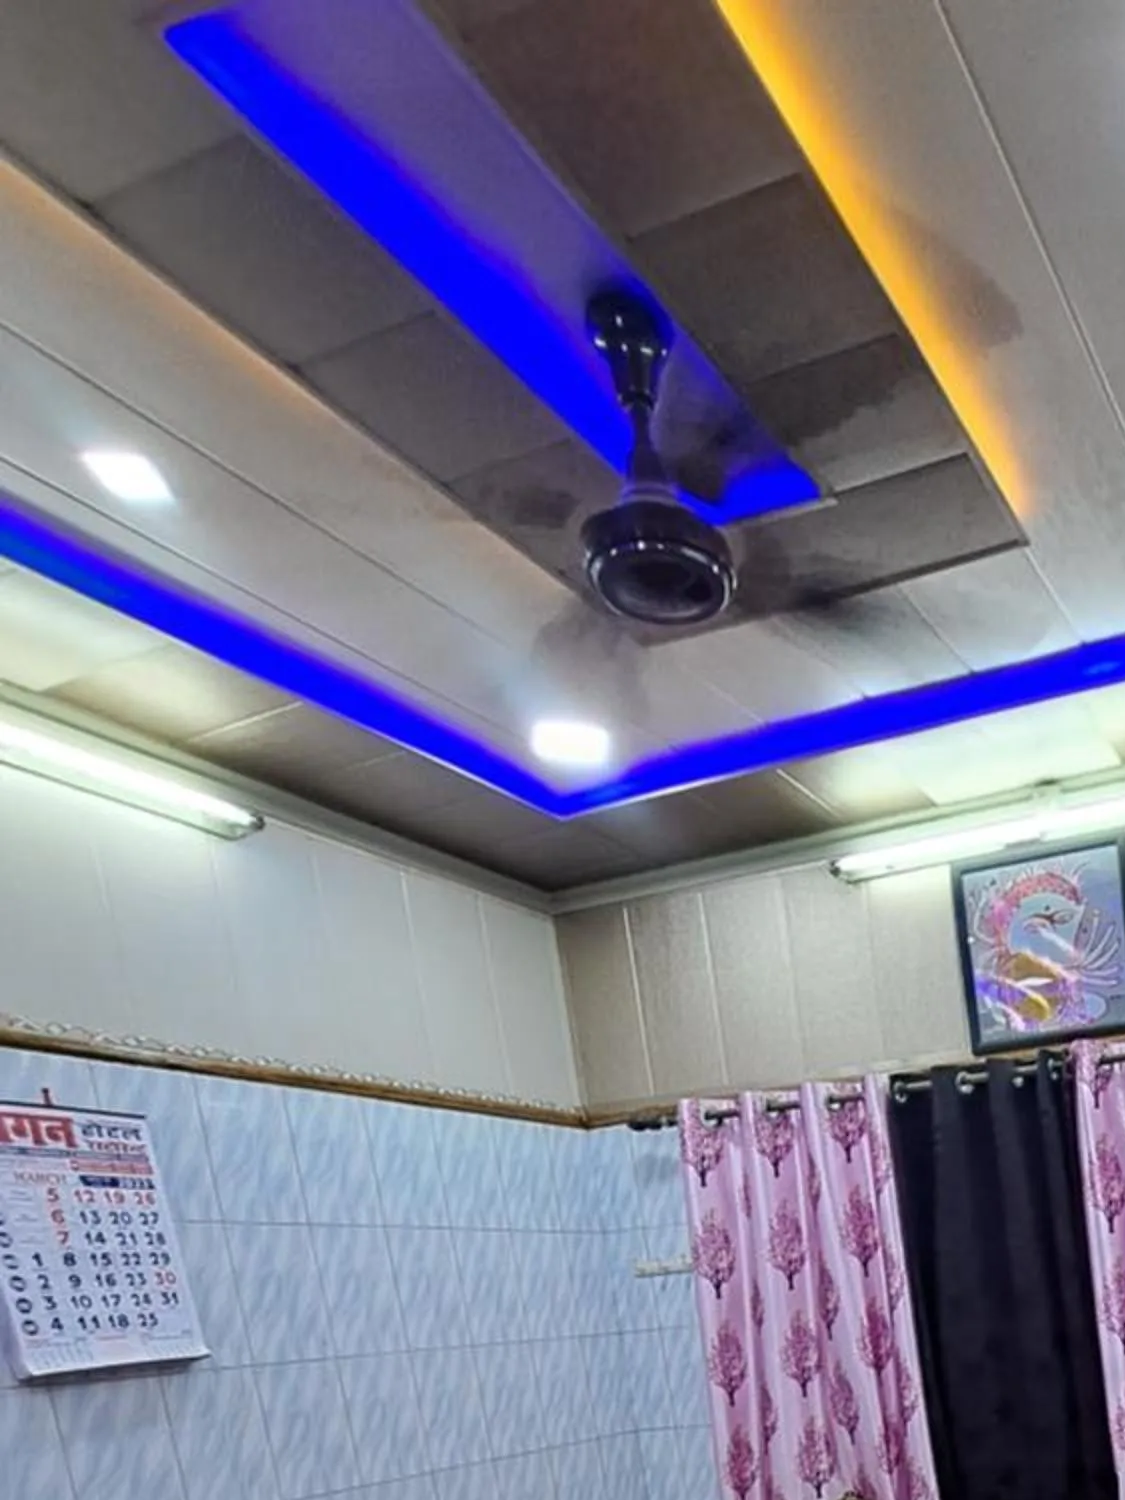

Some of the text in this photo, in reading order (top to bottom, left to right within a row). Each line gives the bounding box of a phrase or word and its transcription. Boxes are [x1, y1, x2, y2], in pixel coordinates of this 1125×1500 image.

[0, 1112, 78, 1148] गन
[47, 1188, 60, 1202] 5
[74, 1190, 96, 1203] 12
[103, 1190, 126, 1204] 19
[51, 1208, 159, 1226] 6 13 20 27
[57, 1230, 69, 1245] 7
[85, 1231, 107, 1246] 14
[115, 1232, 138, 1246] 21
[32, 1252, 43, 1267] 1
[63, 1252, 77, 1267] 8
[90, 1252, 112, 1267] 15
[120, 1252, 141, 1267] 22
[37, 1271, 177, 1290] 2 9 16 23 30
[42, 1295, 57, 1311] 3
[71, 1295, 93, 1310] 10
[101, 1294, 121, 1308] 17
[161, 1292, 179, 1306] 31
[51, 1312, 159, 1331] 4 11 18 25
